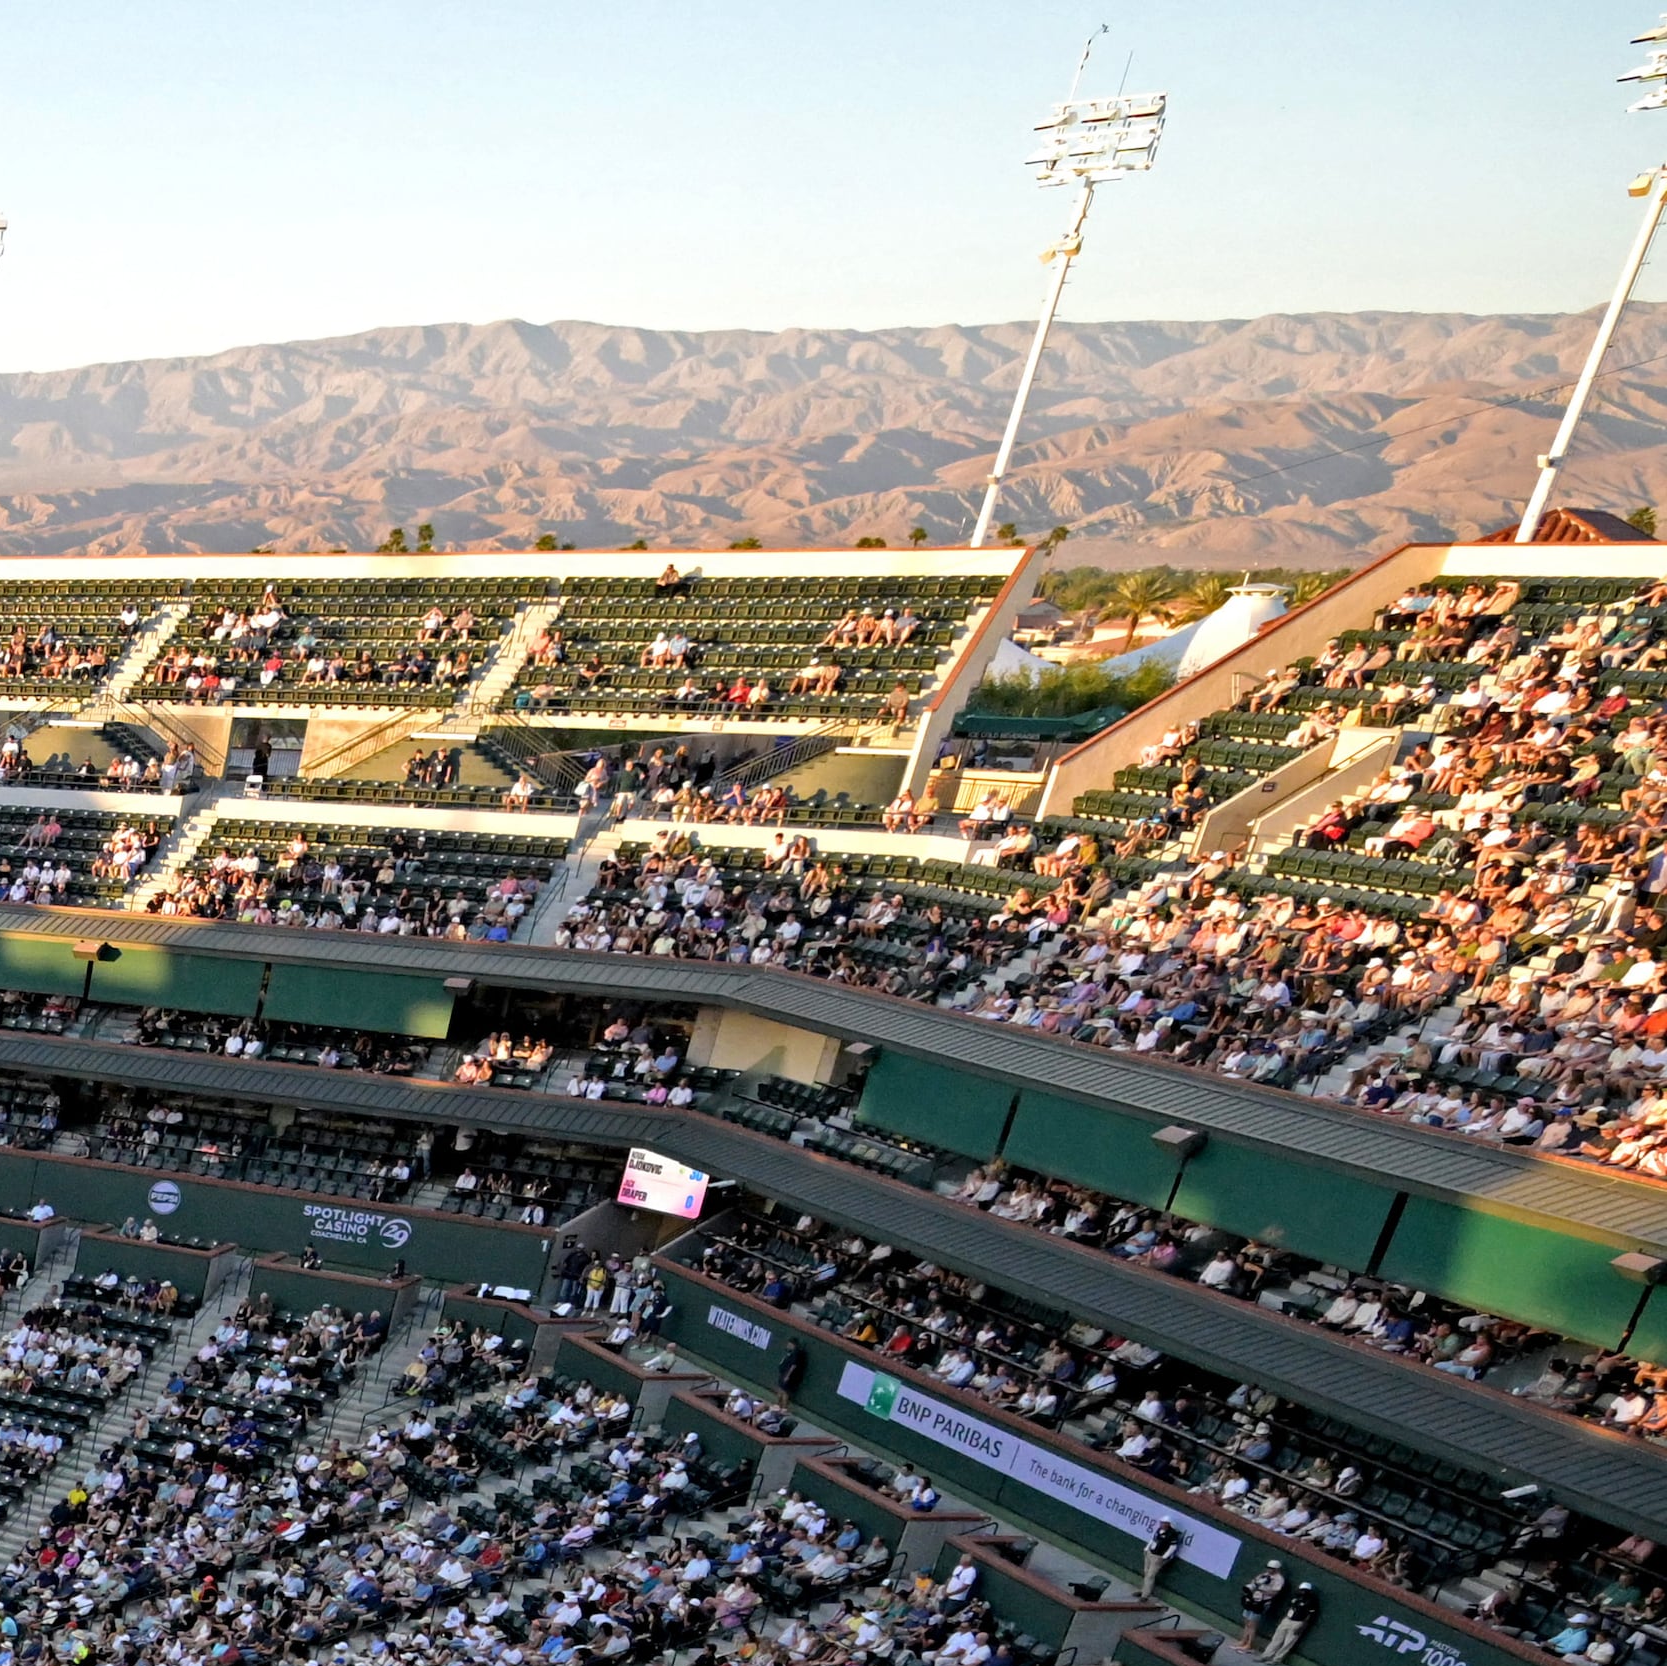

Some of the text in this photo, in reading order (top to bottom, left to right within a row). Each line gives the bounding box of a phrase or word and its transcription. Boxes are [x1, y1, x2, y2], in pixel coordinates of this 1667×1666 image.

[628, 1158, 664, 1175] DJOKOVIC
[620, 1187, 648, 1202] DRAPER
[685, 1195, 694, 1209] 0
[303, 1205, 385, 1227] SPOTLIGHT
[314, 1218, 368, 1236] CASINO
[356, 1236, 368, 1244] CA
[707, 1304, 771, 1351] WTATENNIS.COM
[897, 1396, 1003, 1459] BNP PARIBAS
[1030, 1459, 1158, 1533] The bank for a changing
[1354, 1615, 1427, 1654] ATP
[1429, 1639, 1462, 1658] MASTERS
